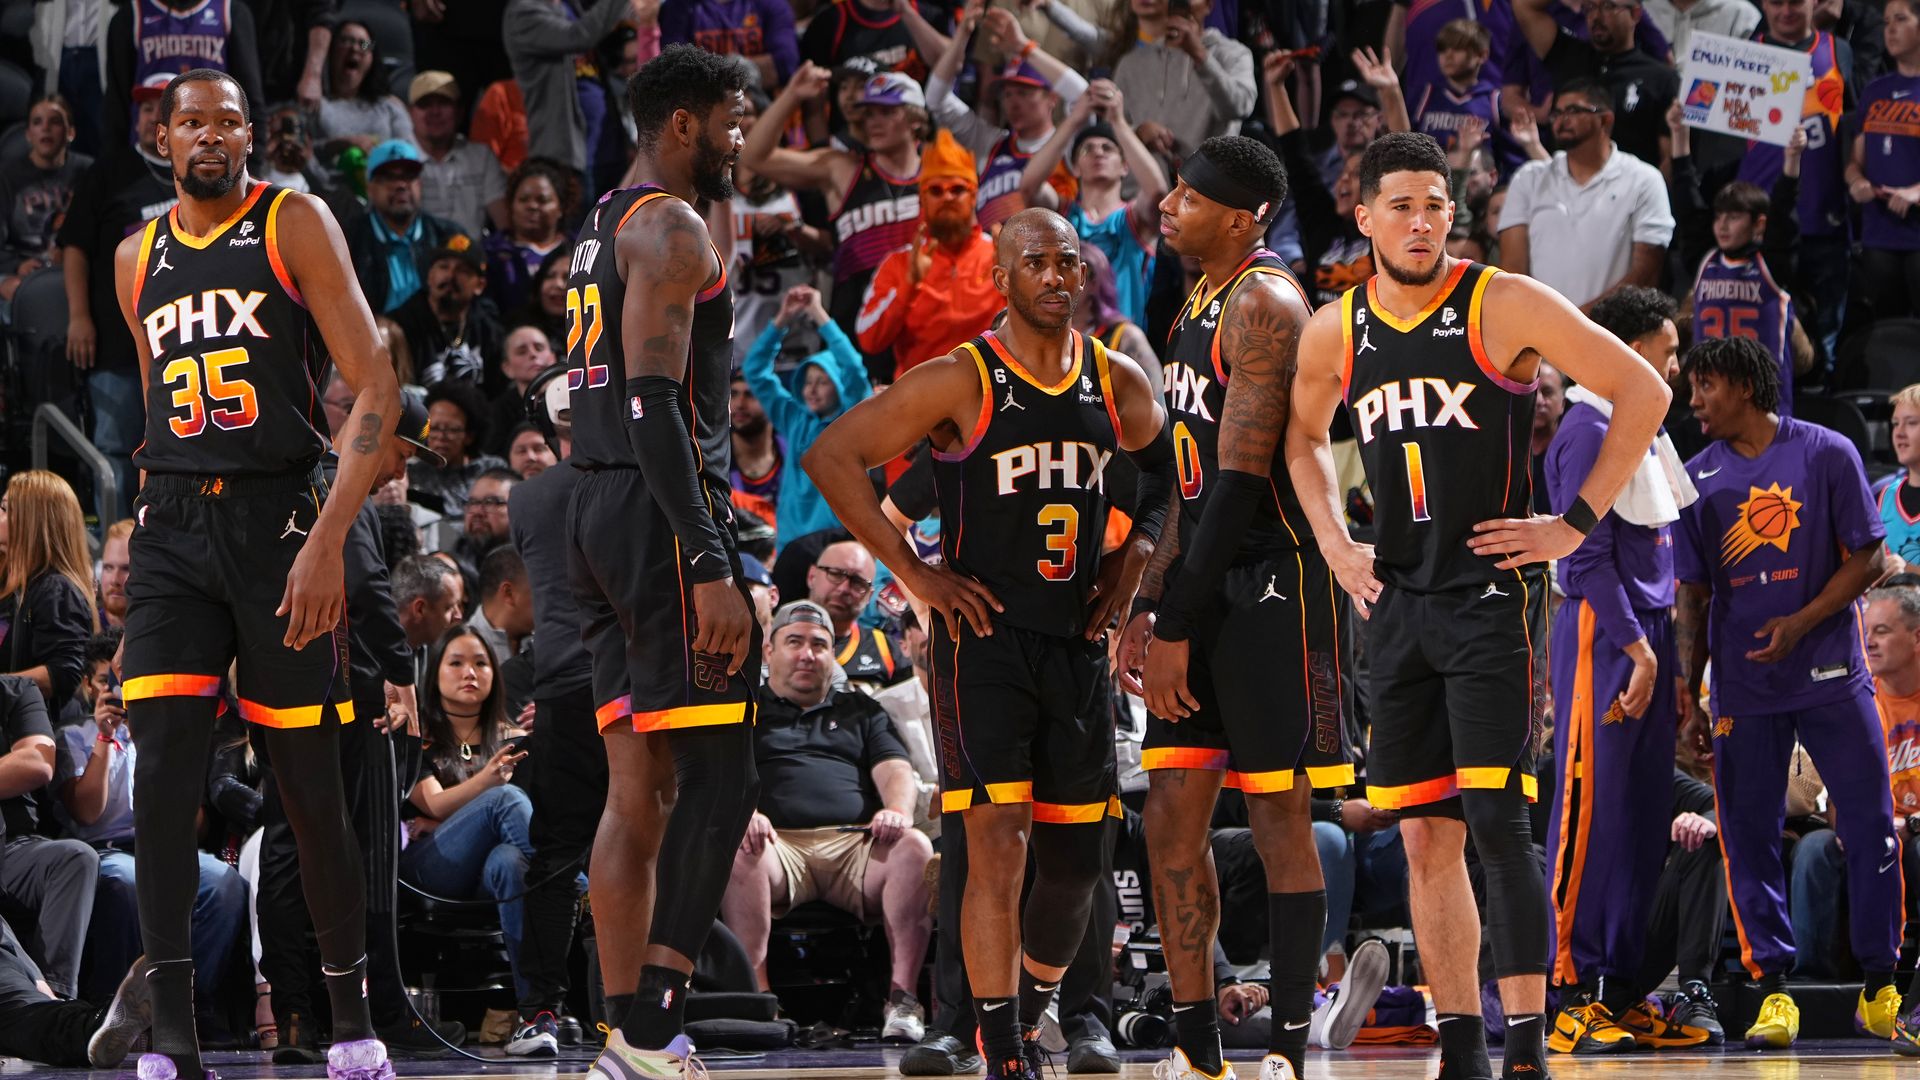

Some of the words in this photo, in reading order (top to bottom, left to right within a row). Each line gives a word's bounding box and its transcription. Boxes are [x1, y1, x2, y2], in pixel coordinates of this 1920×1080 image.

[142, 34, 226, 65] PHOENIX
[976, 169, 1023, 211] SUN
[155, 234, 167, 249] 6
[229, 237, 260, 247] PayPal
[836, 194, 920, 242] SUNS
[1355, 307, 1366, 325] 6
[1699, 280, 1763, 304] PHOENIX
[143, 288, 272, 360] PHX
[566, 283, 609, 391] 22
[1432, 327, 1464, 338] PayPal
[163, 346, 259, 439] 35
[994, 368, 1008, 384] 6
[1353, 377, 1481, 444] PHX
[990, 441, 1113, 496] PHX
[1172, 420, 1203, 500] 0
[1401, 441, 1432, 522] 1
[1037, 503, 1080, 582] 3
[1771, 567, 1799, 582] SUNS
[1113, 869, 1145, 935] SUNS
